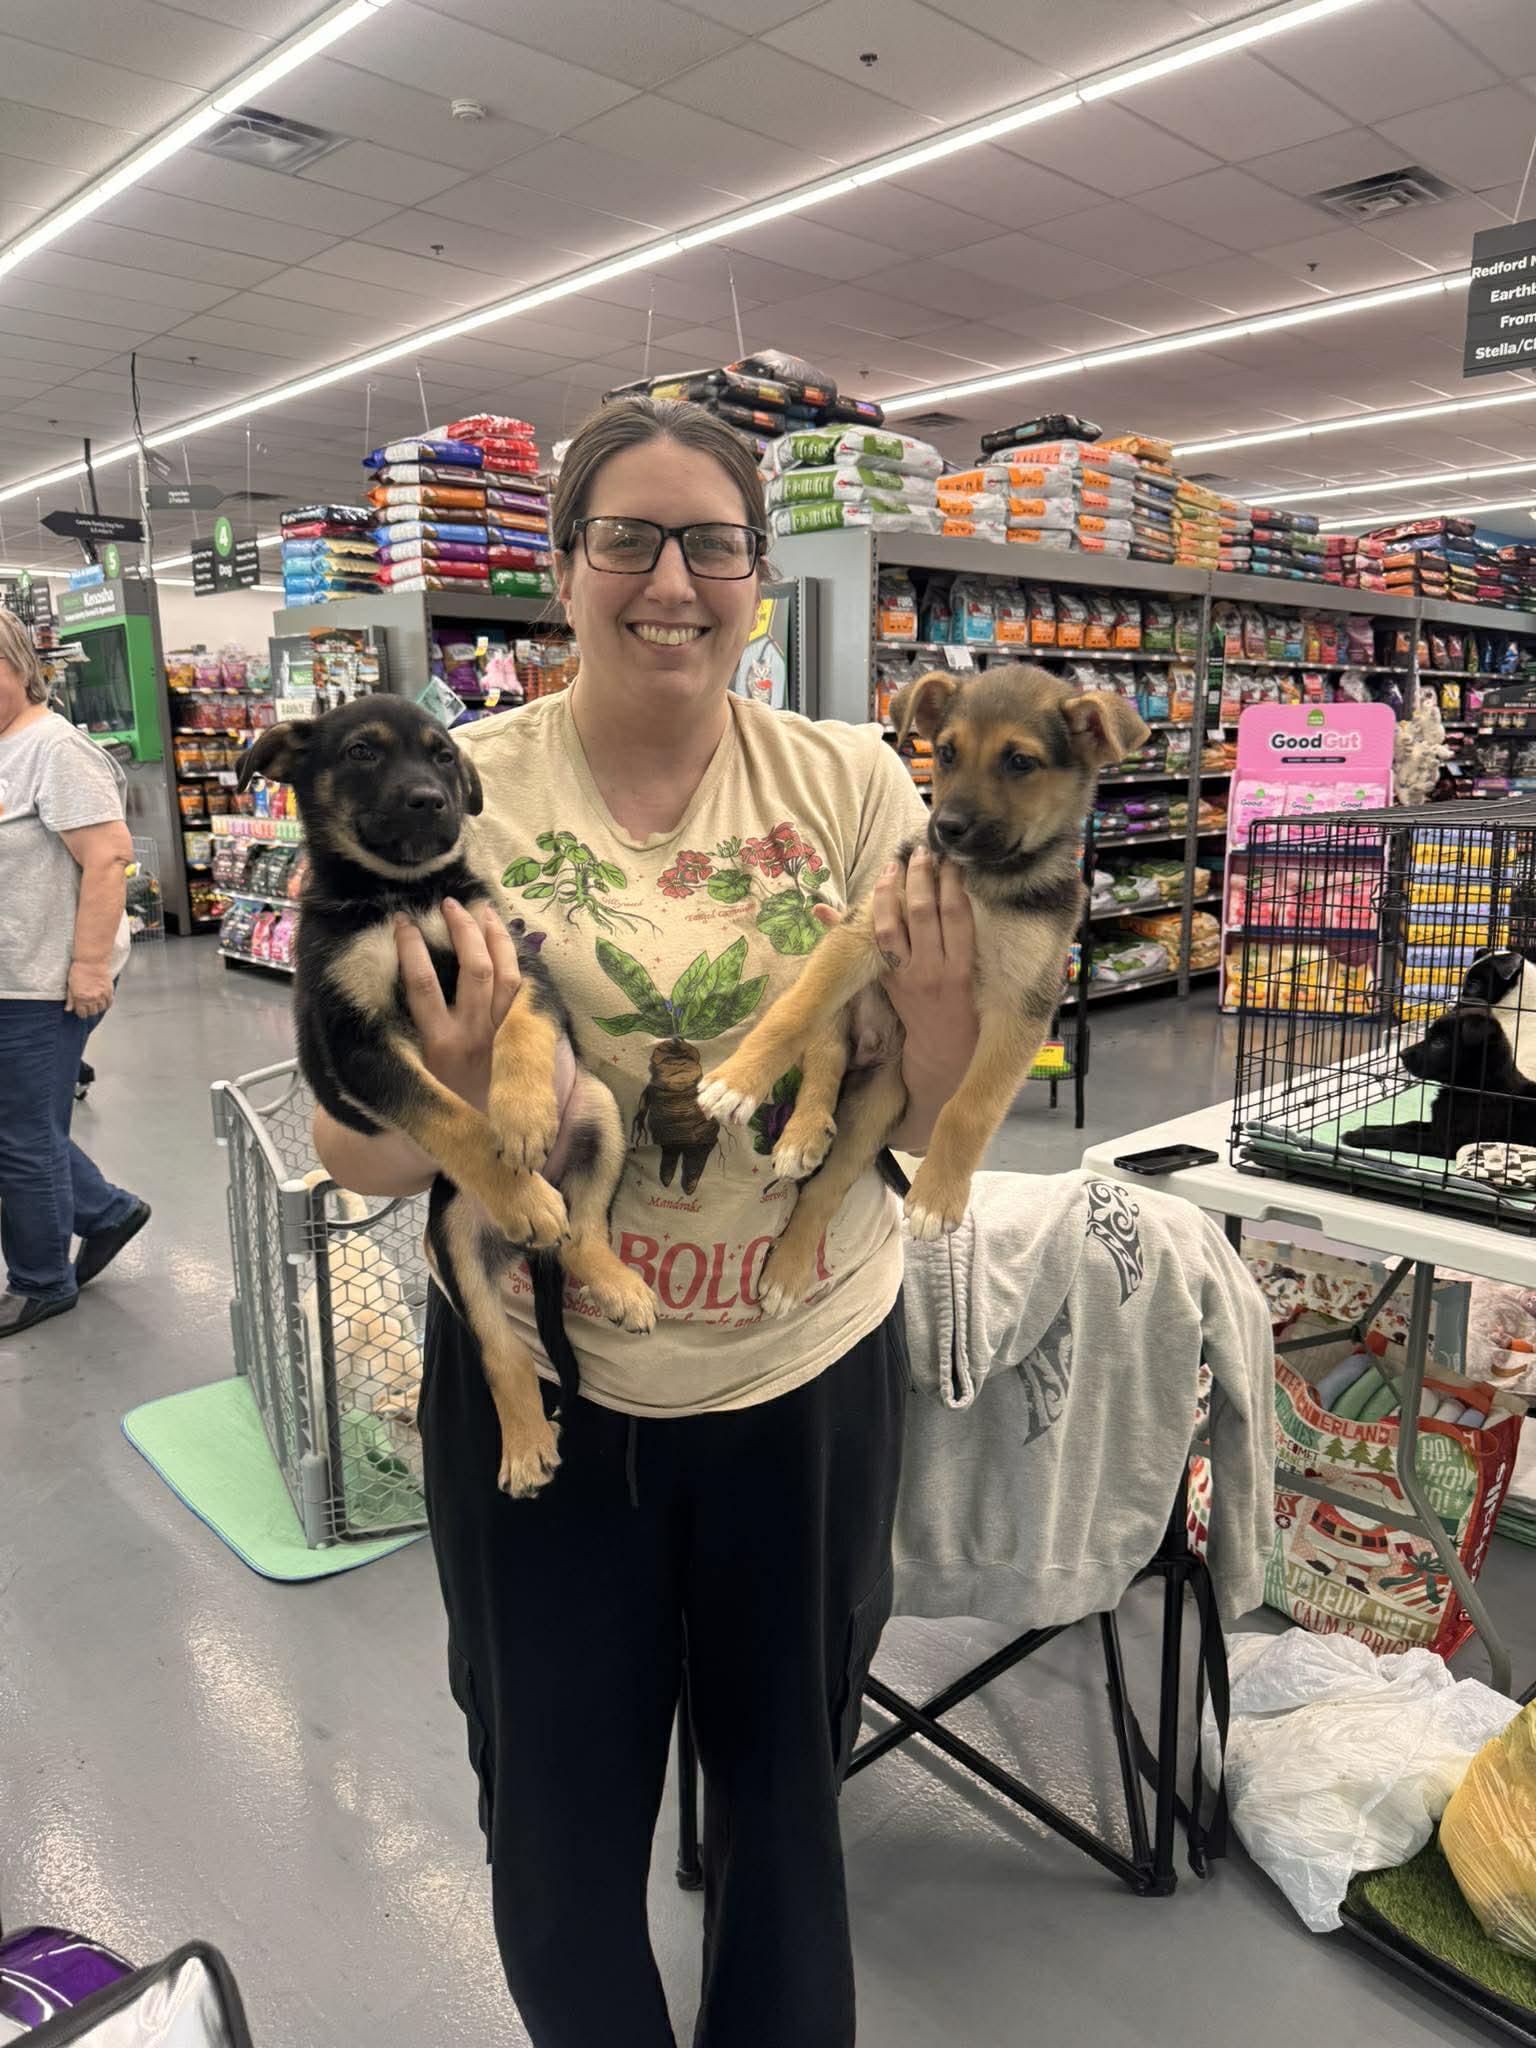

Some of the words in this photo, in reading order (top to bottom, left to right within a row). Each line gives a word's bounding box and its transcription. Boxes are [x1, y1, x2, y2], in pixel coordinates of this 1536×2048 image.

[1472, 256, 1527, 279] Redford
[1475, 338, 1536, 360] Stella/C
[219, 526, 228, 546] 4
[219, 564, 232, 577] Dog
[1422, 1438, 1452, 1462] HO!
[1427, 1462, 1466, 1491] HO!
[1286, 1566, 1362, 1620] JOYEUX
[1293, 1600, 1339, 1636] CALM
